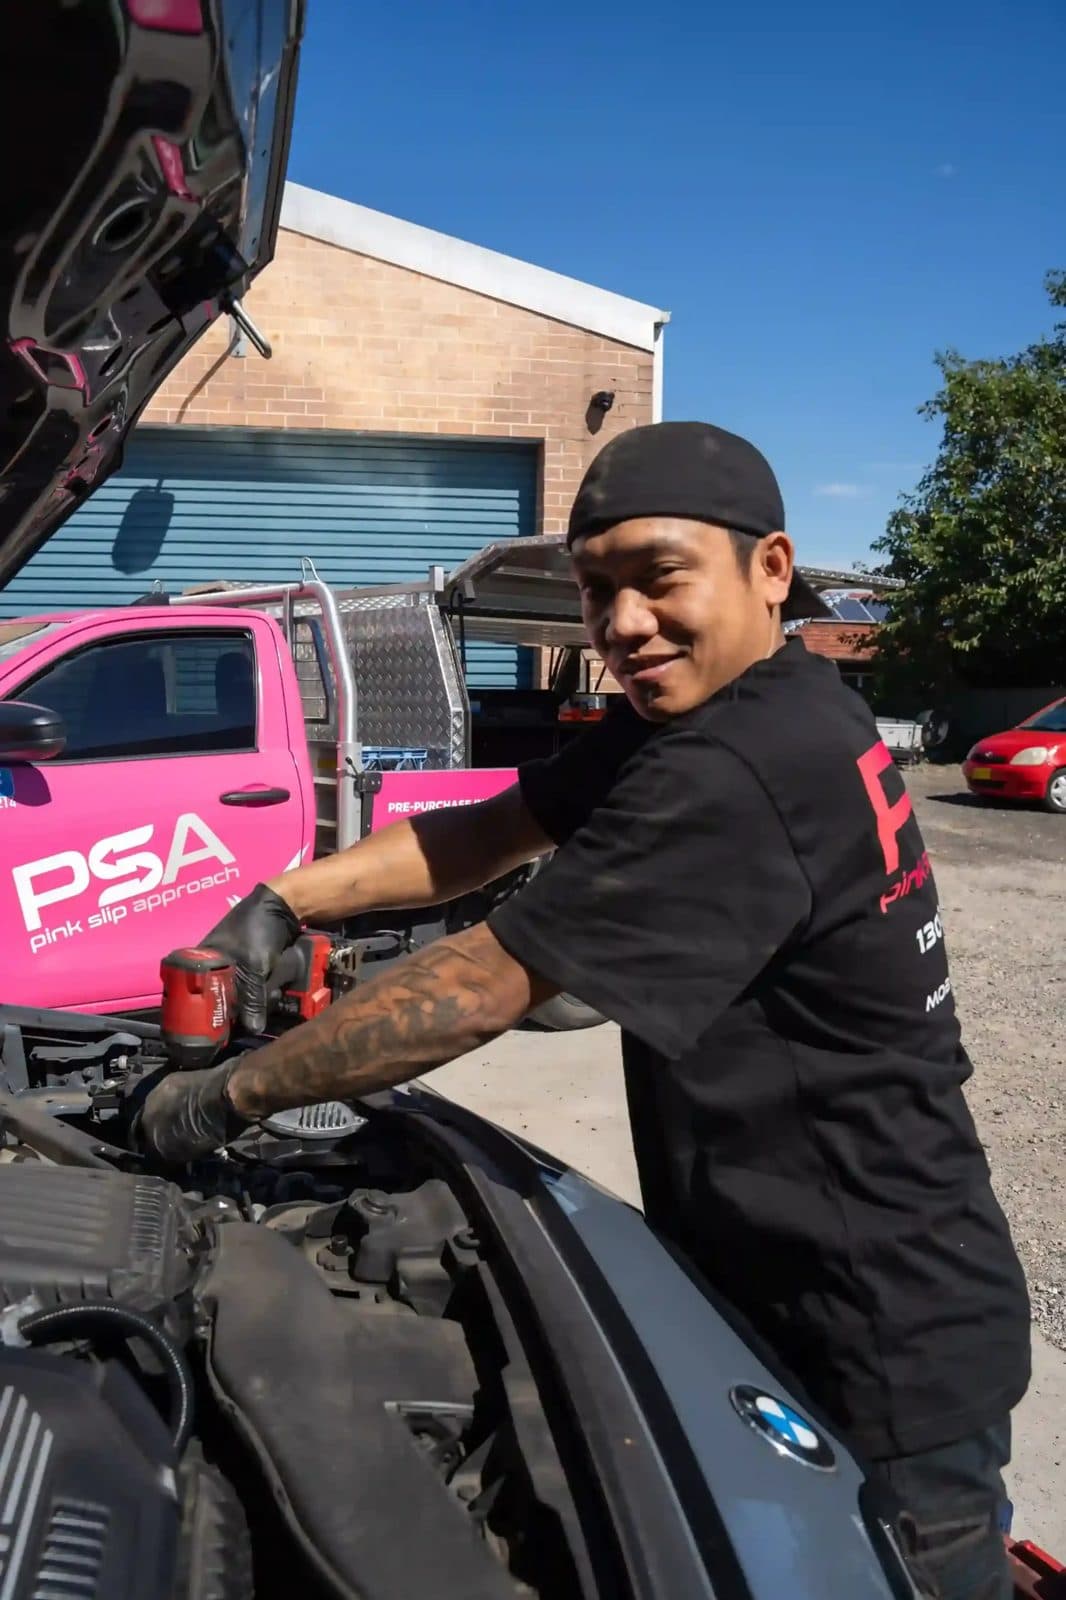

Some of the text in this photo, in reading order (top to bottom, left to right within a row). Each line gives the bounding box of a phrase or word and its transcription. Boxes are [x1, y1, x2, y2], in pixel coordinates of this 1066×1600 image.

[12, 812, 237, 932] PSA
[30, 867, 240, 954] pink slip approach
